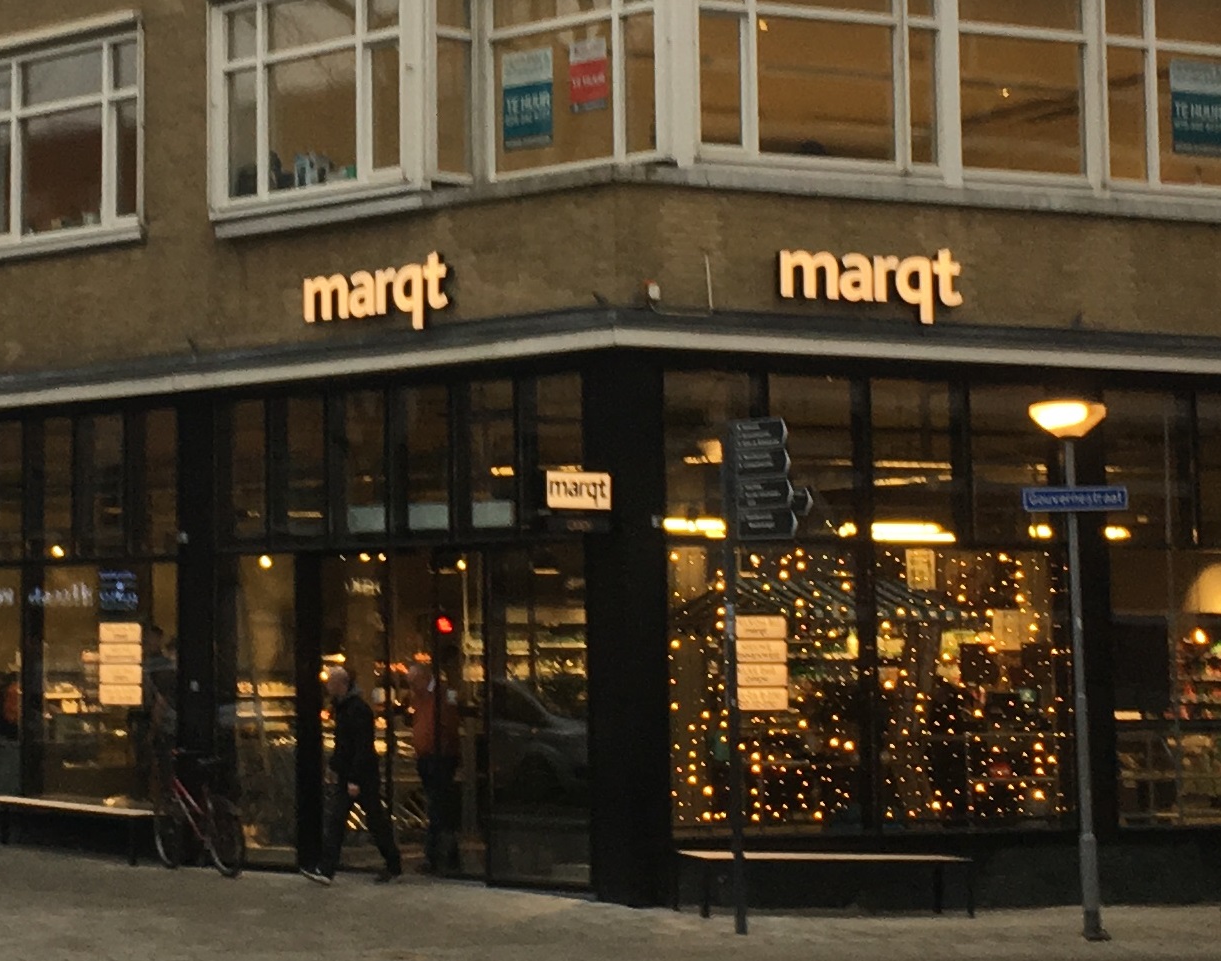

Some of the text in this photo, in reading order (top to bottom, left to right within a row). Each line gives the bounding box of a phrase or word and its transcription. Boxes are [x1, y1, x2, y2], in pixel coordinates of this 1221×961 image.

[303, 250, 449, 330] marqt
[780, 248, 964, 324] marqt
[549, 480, 607, 508] marqt
